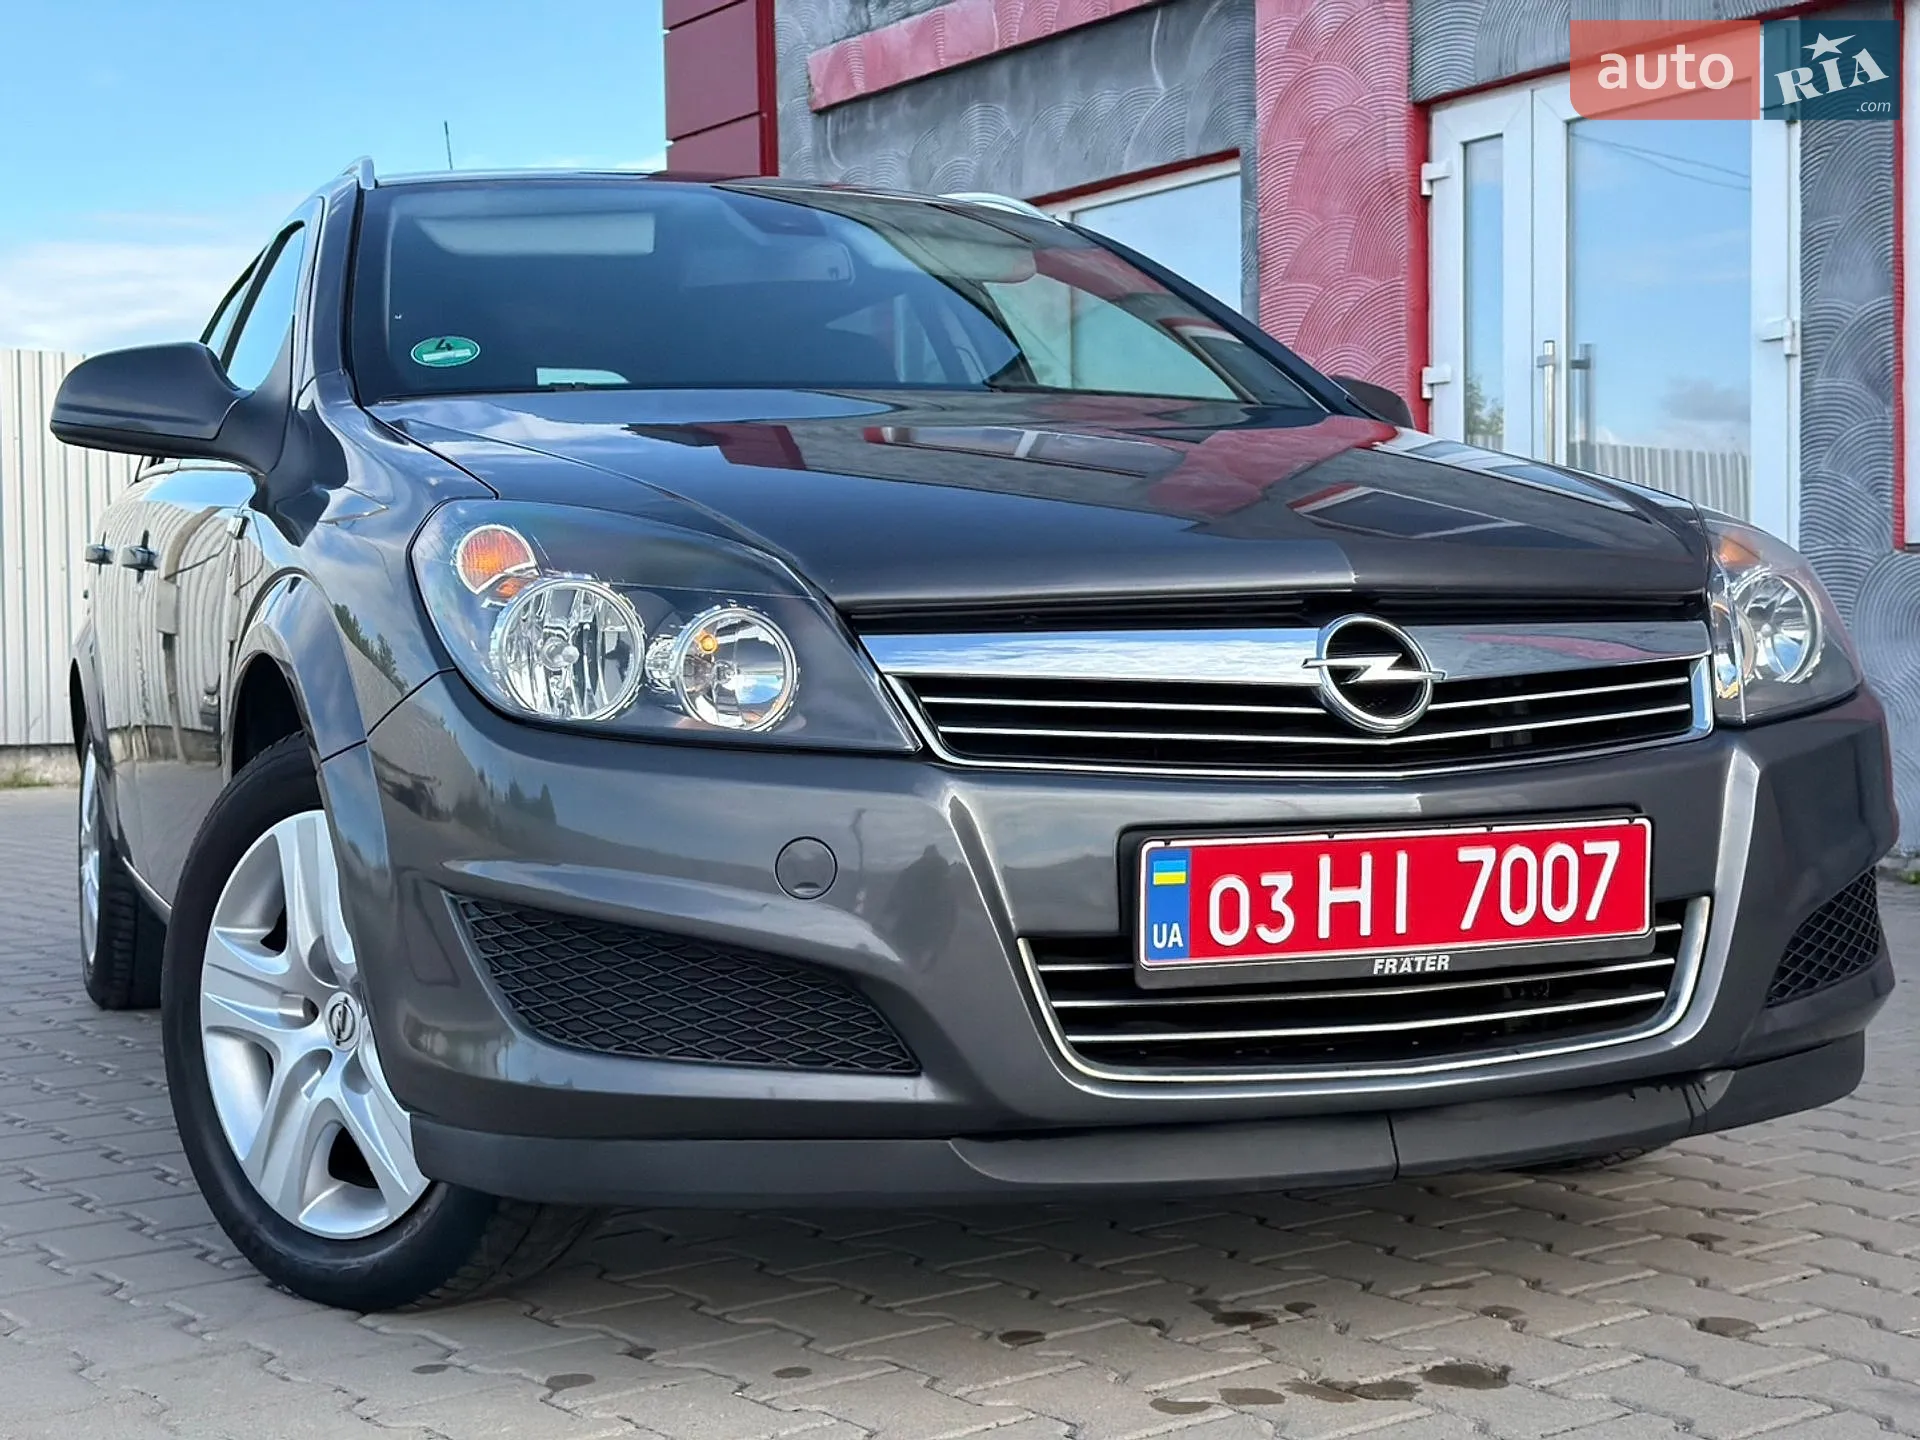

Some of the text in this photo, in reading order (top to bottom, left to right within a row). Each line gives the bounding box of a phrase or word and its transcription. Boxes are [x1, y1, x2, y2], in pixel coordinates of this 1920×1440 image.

[1208, 840, 1620, 947] 03 HI 7007
[1153, 922, 1184, 949] UA
